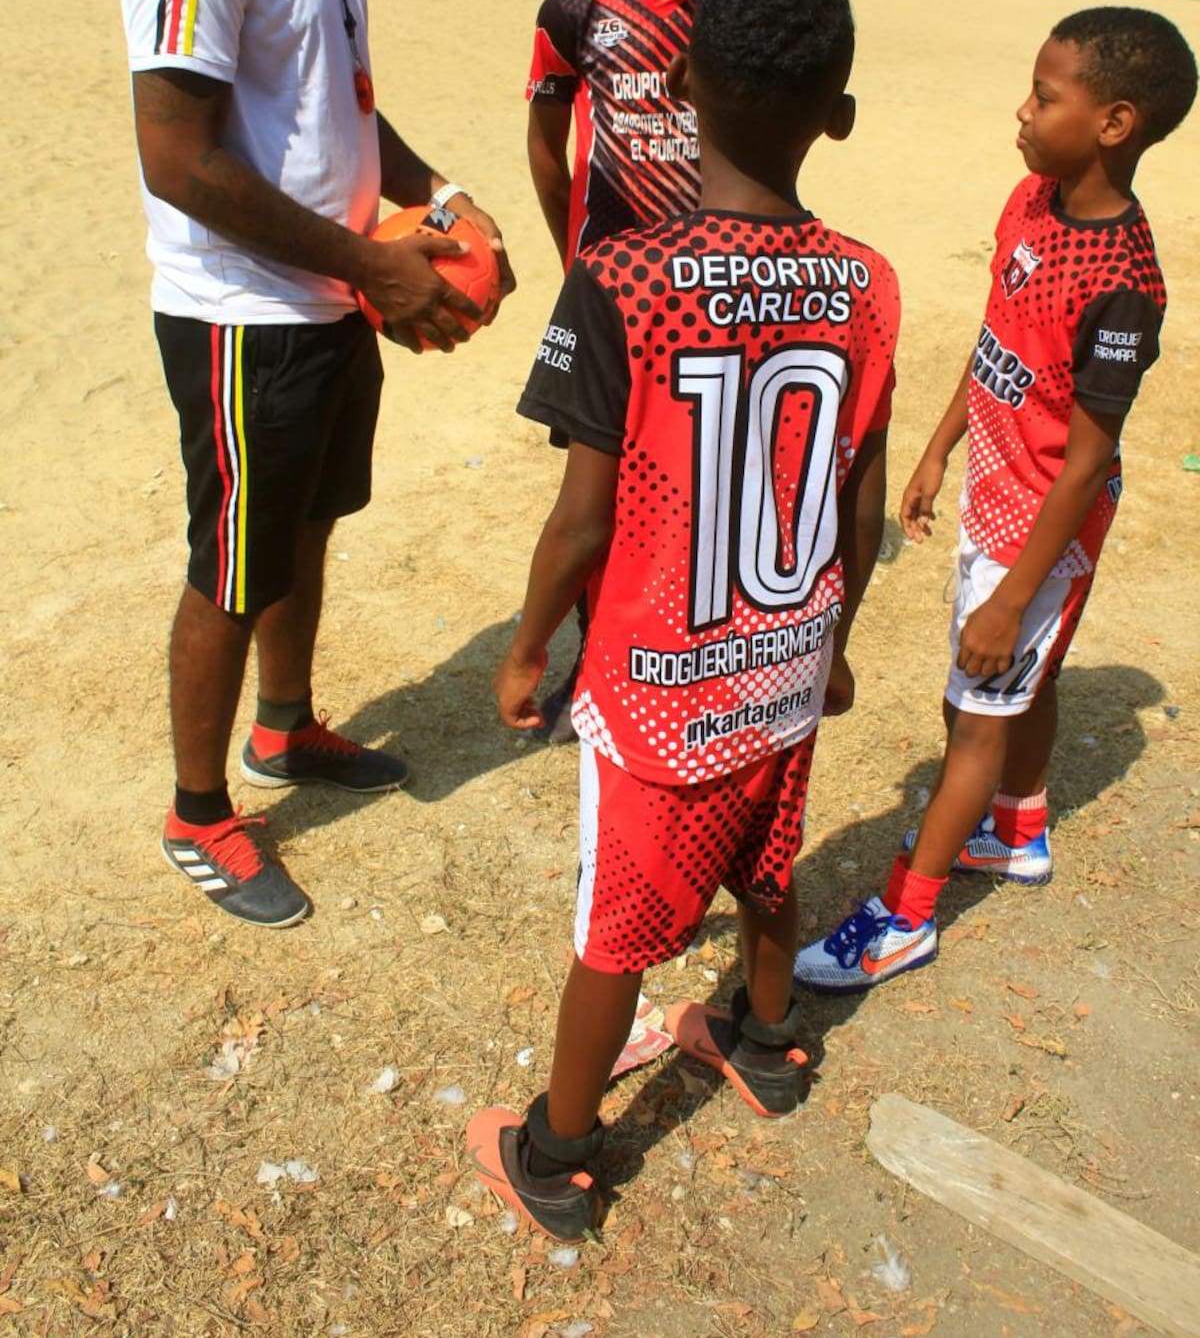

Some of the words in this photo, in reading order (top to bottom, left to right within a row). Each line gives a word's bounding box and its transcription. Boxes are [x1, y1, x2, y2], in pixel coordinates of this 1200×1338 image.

[612, 71, 660, 100] GRUPO
[666, 112, 674, 135] Y
[631, 138, 646, 162] EL
[649, 137, 700, 162] PUNTAZ
[672, 255, 870, 290] DEPORTIVO
[708, 291, 851, 326] CARLOS
[676, 347, 850, 629] 10
[630, 632, 747, 686] DROGUERÍA
